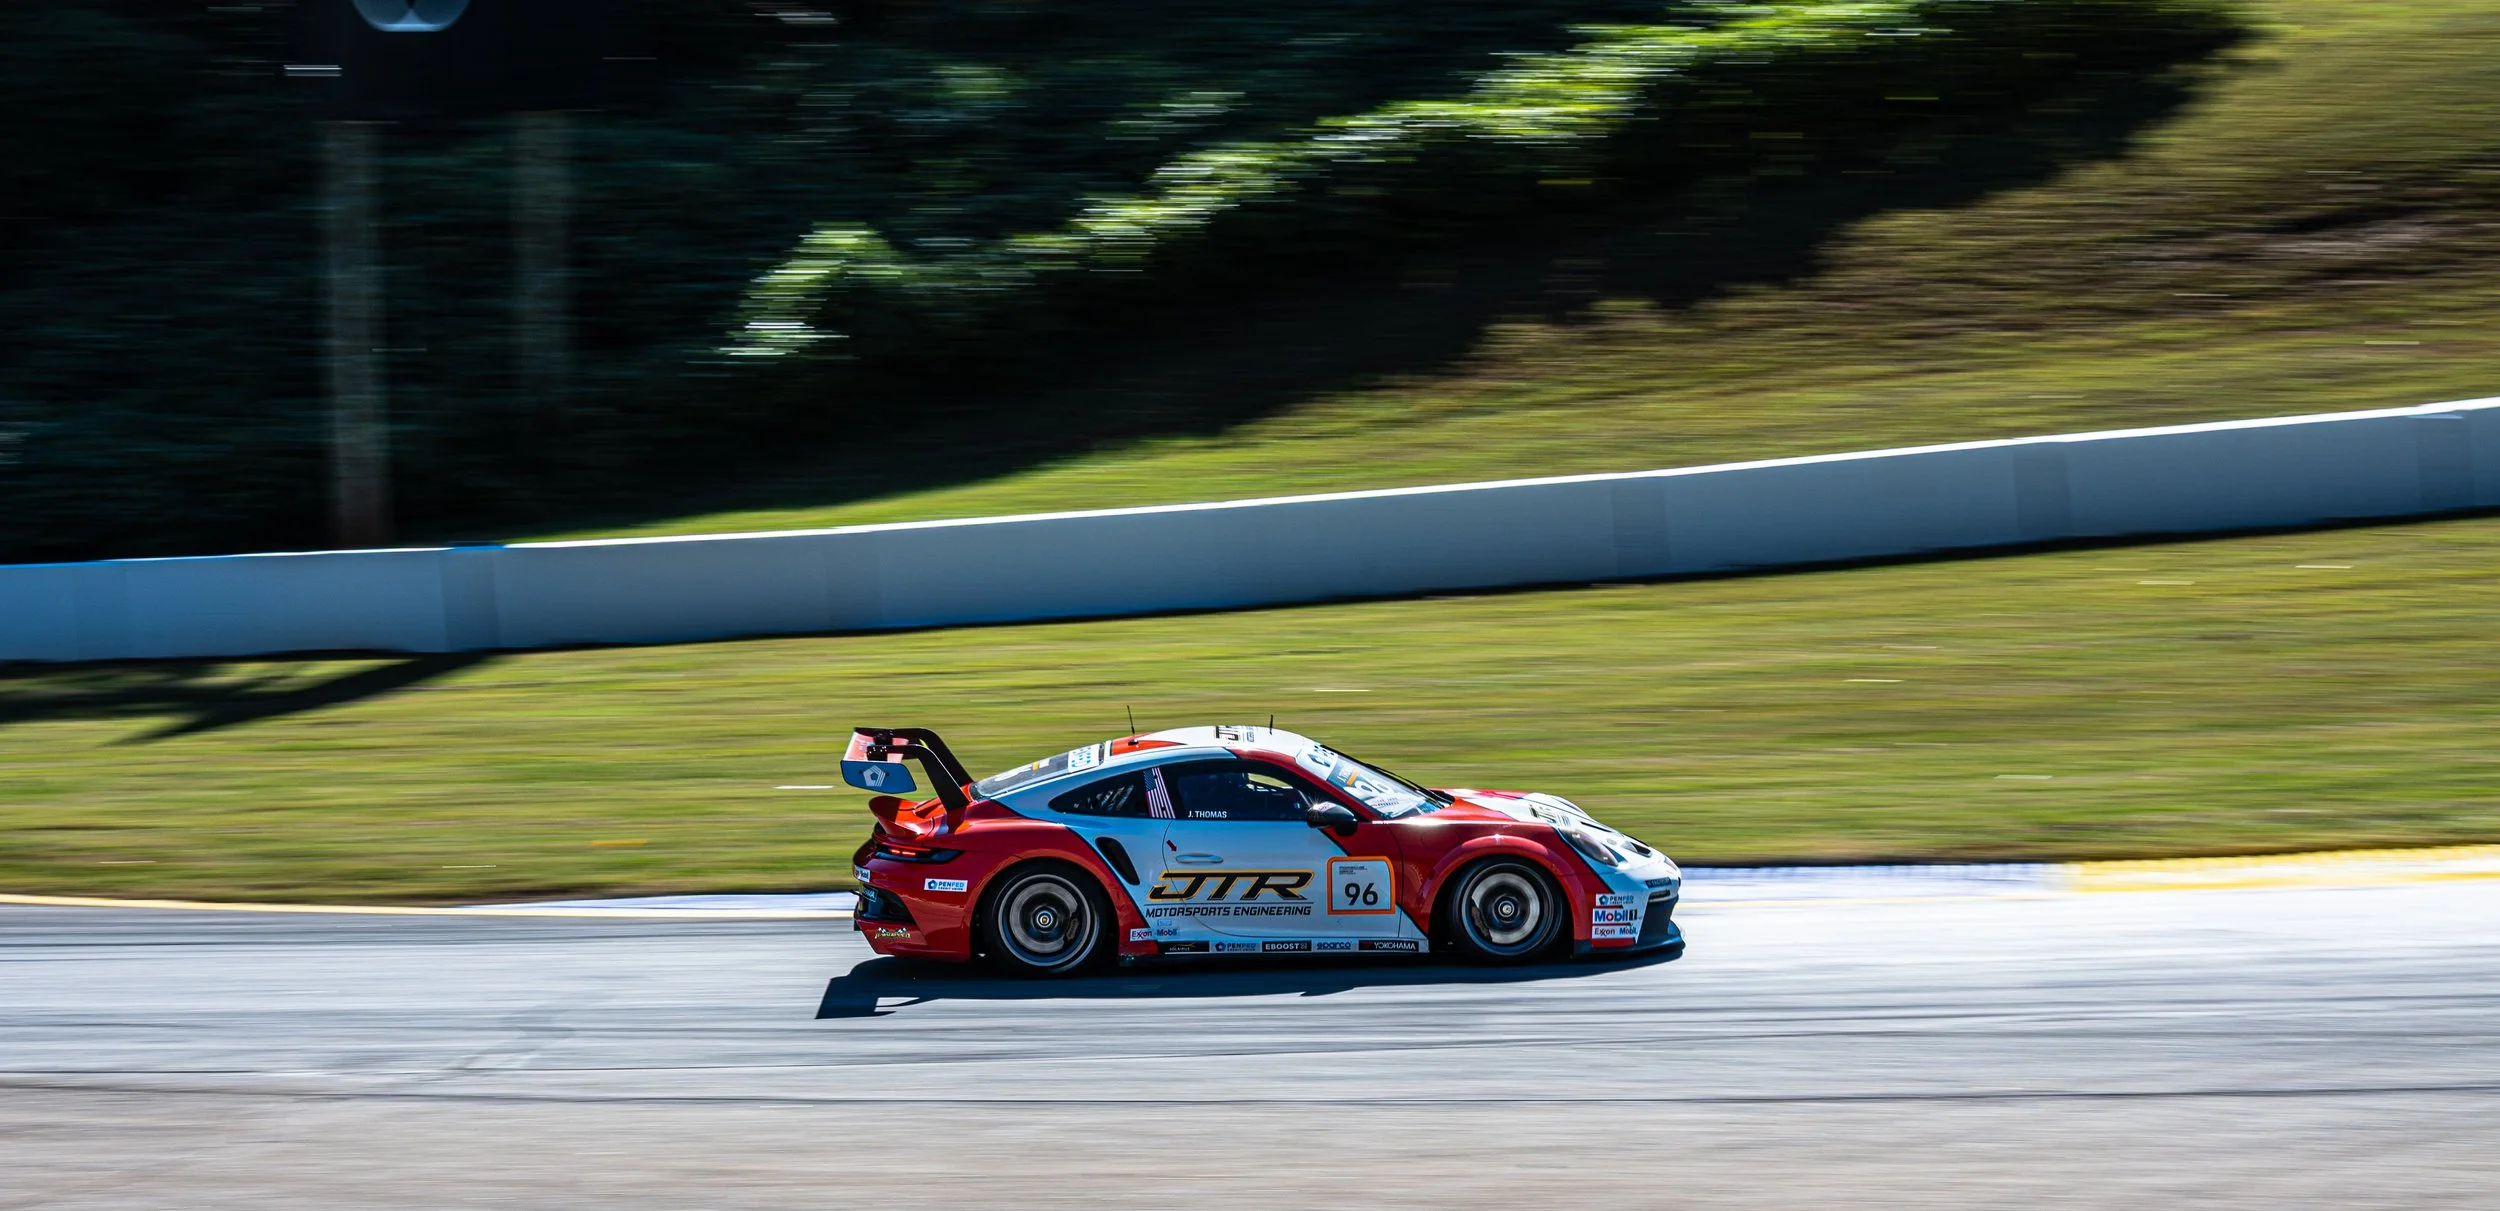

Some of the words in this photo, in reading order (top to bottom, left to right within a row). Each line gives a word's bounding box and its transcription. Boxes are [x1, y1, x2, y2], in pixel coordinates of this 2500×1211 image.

[1195, 811, 1227, 819] THOMAS
[1148, 869, 1314, 902] JTR
[1344, 882, 1379, 906] 96
[1145, 906, 1231, 918] MOTORSPORTS
[1233, 905, 1312, 916] ENGINEERING
[1595, 910, 1628, 922] Mobil
[1131, 930, 1152, 939] Exxon
[1156, 928, 1178, 937] Mobil
[1594, 927, 1616, 937] Exxon
[1619, 926, 1637, 935] Mobil
[1373, 942, 1416, 950] YOKOHAMA
